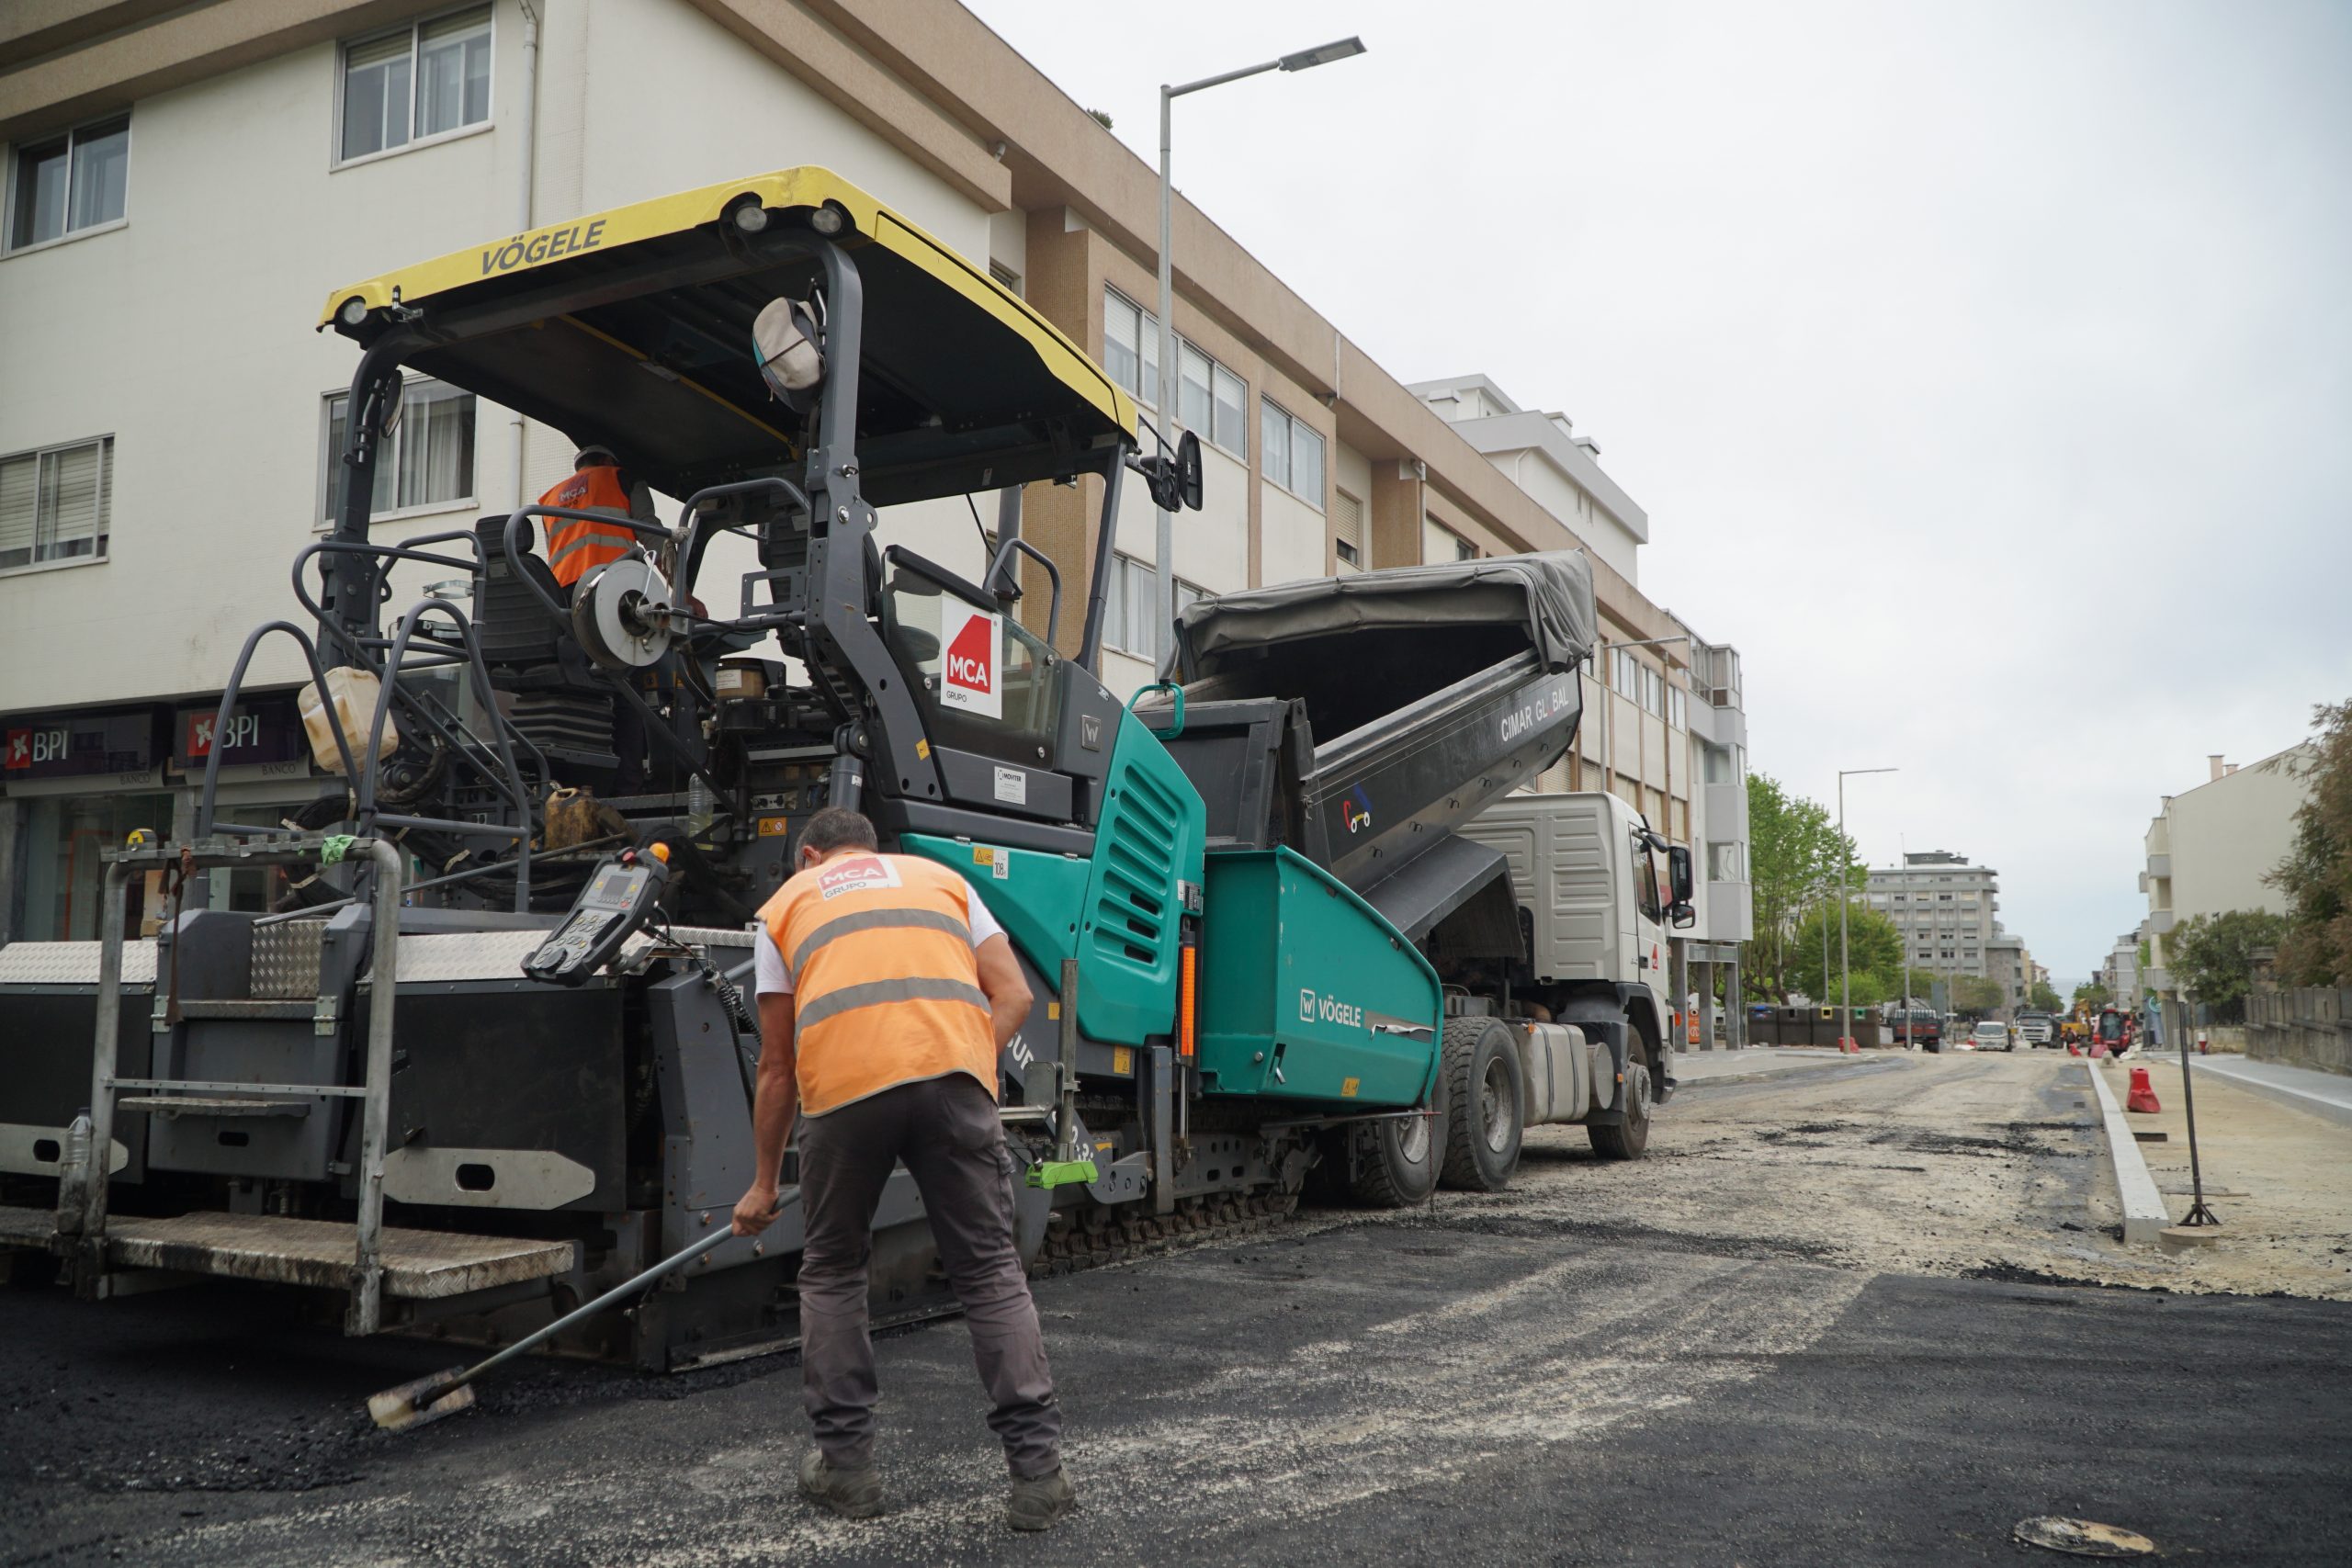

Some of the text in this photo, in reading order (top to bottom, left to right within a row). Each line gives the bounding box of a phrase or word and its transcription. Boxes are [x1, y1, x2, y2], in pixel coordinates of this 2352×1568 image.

[482, 219, 606, 275] VÖGELE
[949, 653, 989, 687] MCA
[946, 690, 967, 703] GRUPO
[1501, 705, 1533, 742] CIMAR
[32, 730, 69, 762] BPI
[119, 773, 151, 785] BANCO
[261, 763, 296, 775] BANCO
[822, 867, 883, 885] MCA
[824, 881, 867, 898] GRUPO
[1318, 994, 1362, 1028] VÖGELE
